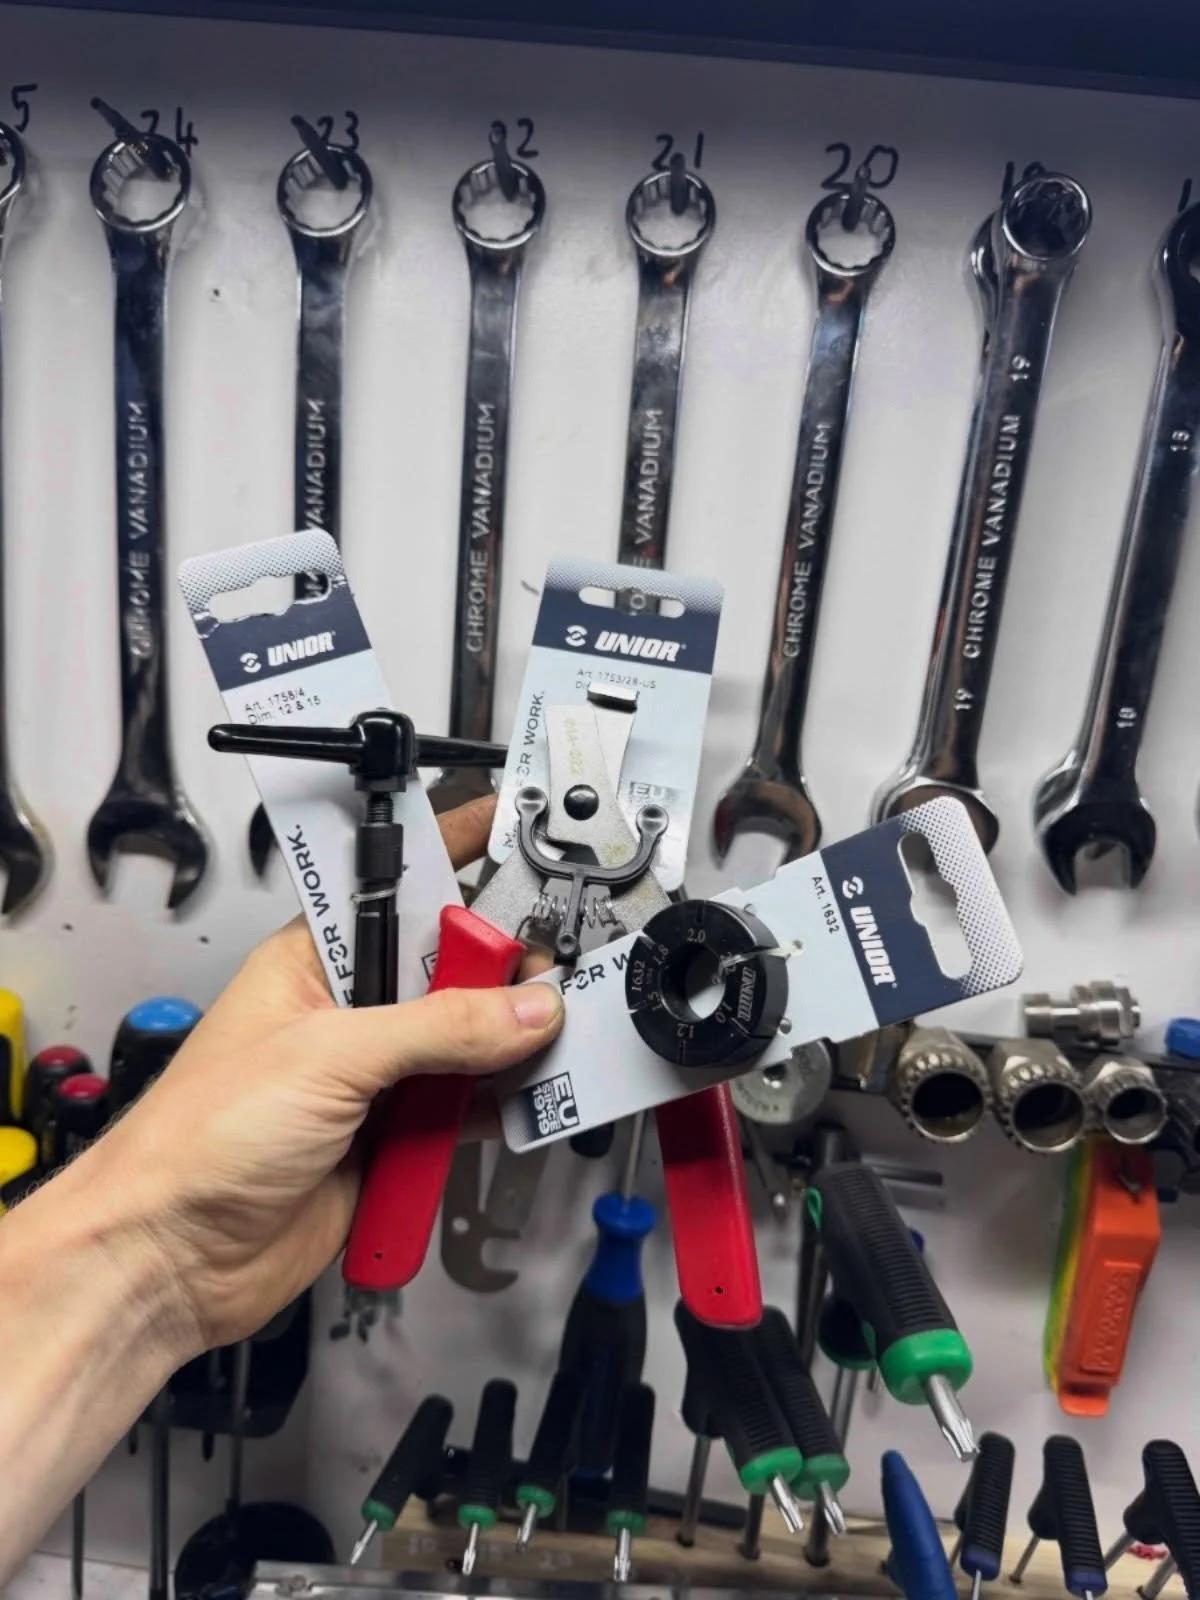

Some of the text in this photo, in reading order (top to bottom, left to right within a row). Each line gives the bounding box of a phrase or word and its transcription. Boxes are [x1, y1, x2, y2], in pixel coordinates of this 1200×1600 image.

[316, 110, 360, 150] 23
[652, 133, 704, 171] 21
[822, 143, 899, 190] 20
[1009, 354, 1031, 382] 19
[127, 400, 150, 540] VANADIUM
[634, 408, 664, 546] VANADIUM
[465, 402, 496, 653] CHROME VANADIUM
[783, 422, 833, 659] CHROME VANADIUM
[962, 413, 1022, 659] CHROME VANADIUM
[266, 632, 334, 666] UNIOR
[594, 630, 681, 662] UNIOR
[278, 704, 294, 717] 12
[296, 701, 305, 711] &
[307, 695, 321, 706] 15
[523, 690, 546, 745] WORK.
[954, 688, 975, 712] 19
[632, 783, 666, 800] EU
[287, 824, 330, 917] WORK.
[811, 875, 840, 935] Art. 1632
[686, 927, 706, 943] 2.0
[850, 906, 896, 985] UNIOR
[559, 963, 606, 996] FOR
[631, 960, 646, 992] 1632
[531, 1084, 551, 1136] 1919
[539, 1082, 562, 1131] SINCE
[552, 1077, 579, 1127] EU
